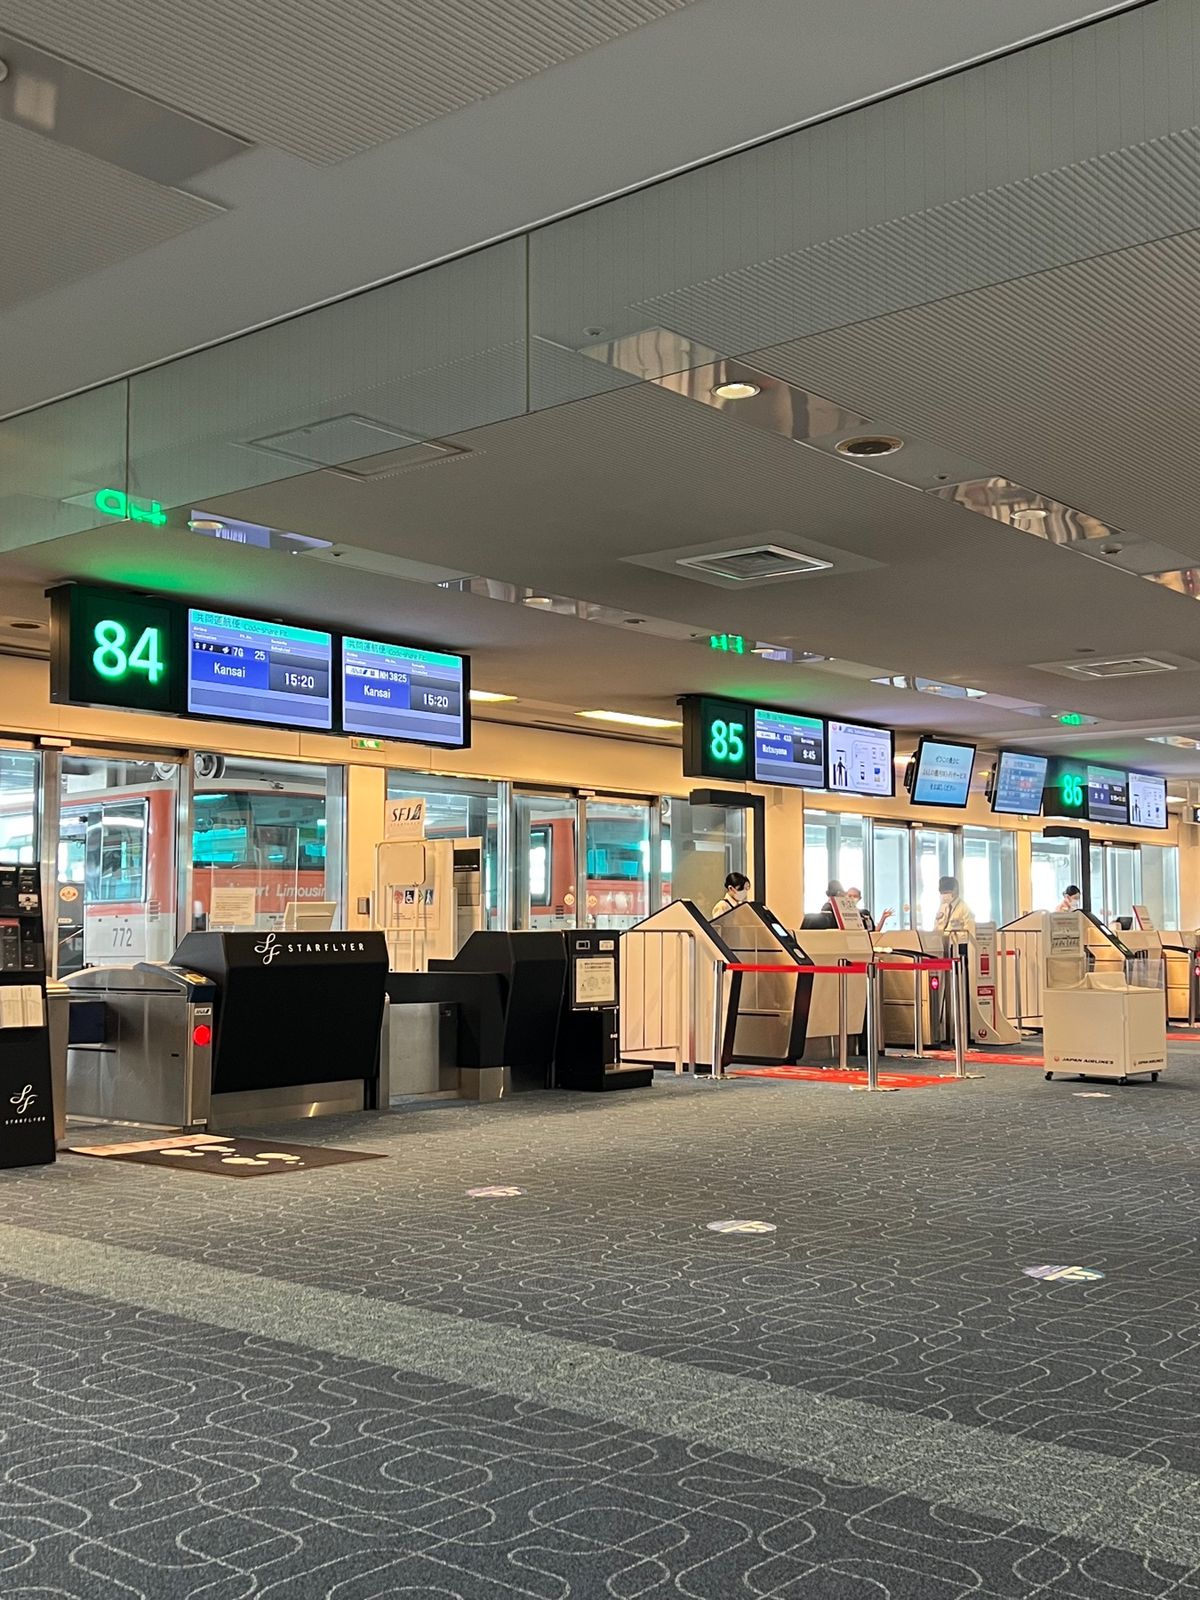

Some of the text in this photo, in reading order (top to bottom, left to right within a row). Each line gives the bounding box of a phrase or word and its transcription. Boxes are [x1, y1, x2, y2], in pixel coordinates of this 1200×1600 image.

[93, 620, 163, 683] 84
[254, 650, 266, 661] 25
[214, 662, 246, 678] Kansai
[284, 672, 315, 689] 15:20
[363, 684, 391, 699] Kansai
[423, 693, 449, 708] 15:20
[711, 720, 744, 762] 85
[1063, 774, 1083, 806] 86
[392, 807, 411, 823] SFJ
[112, 928, 132, 947] 772
[287, 942, 366, 953] STARFLYER
